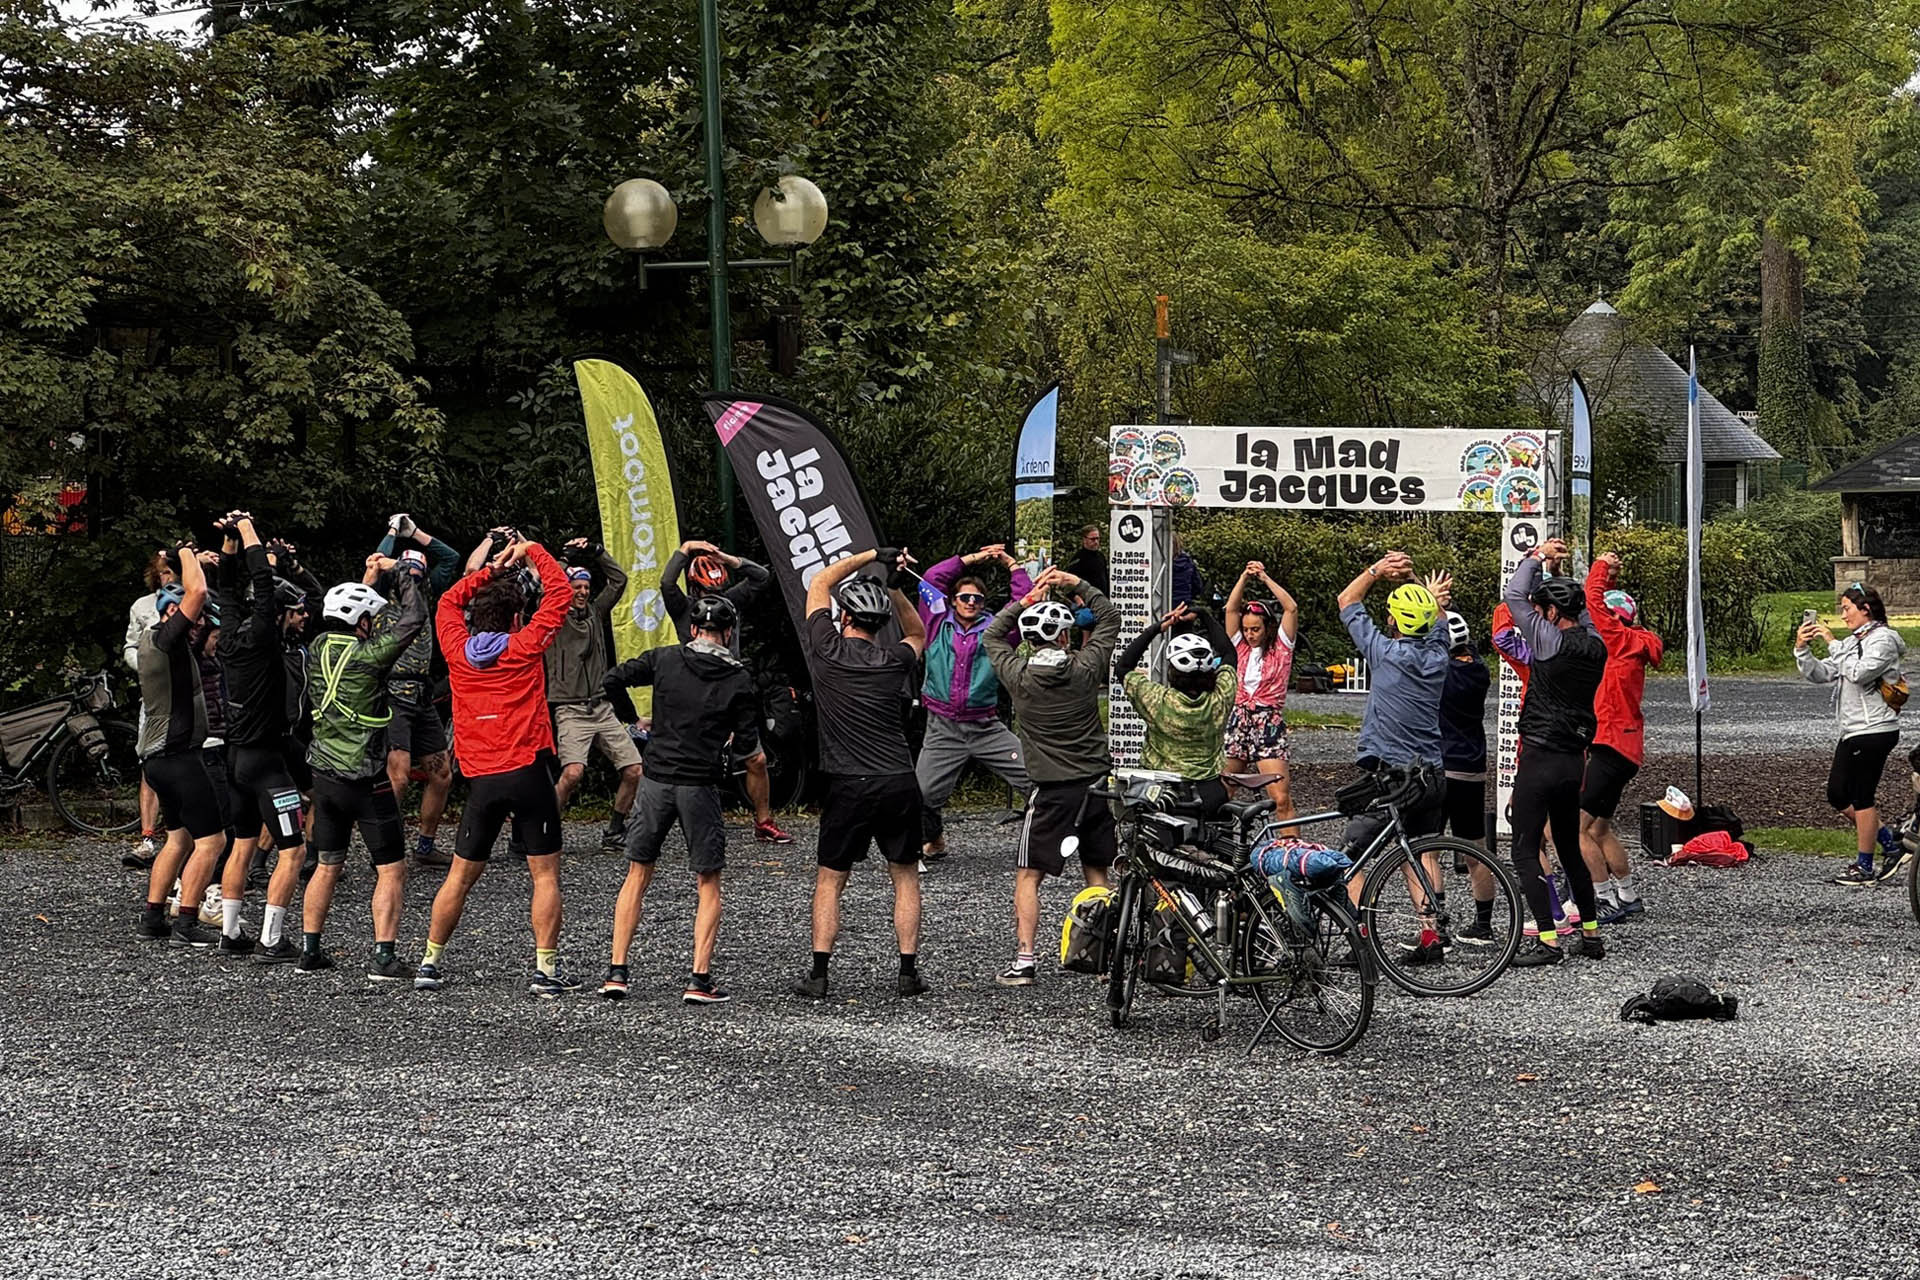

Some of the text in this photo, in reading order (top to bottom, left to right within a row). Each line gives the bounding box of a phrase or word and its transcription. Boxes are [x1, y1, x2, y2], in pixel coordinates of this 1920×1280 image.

[1236, 433, 1401, 474] la Mad
[612, 412, 656, 571] komoot
[790, 447, 824, 500] la
[1219, 470, 1426, 508] Jacques
[1111, 557, 1149, 566] Jacques
[1111, 574, 1149, 583] Jacques
[1110, 592, 1149, 600] Jacques
